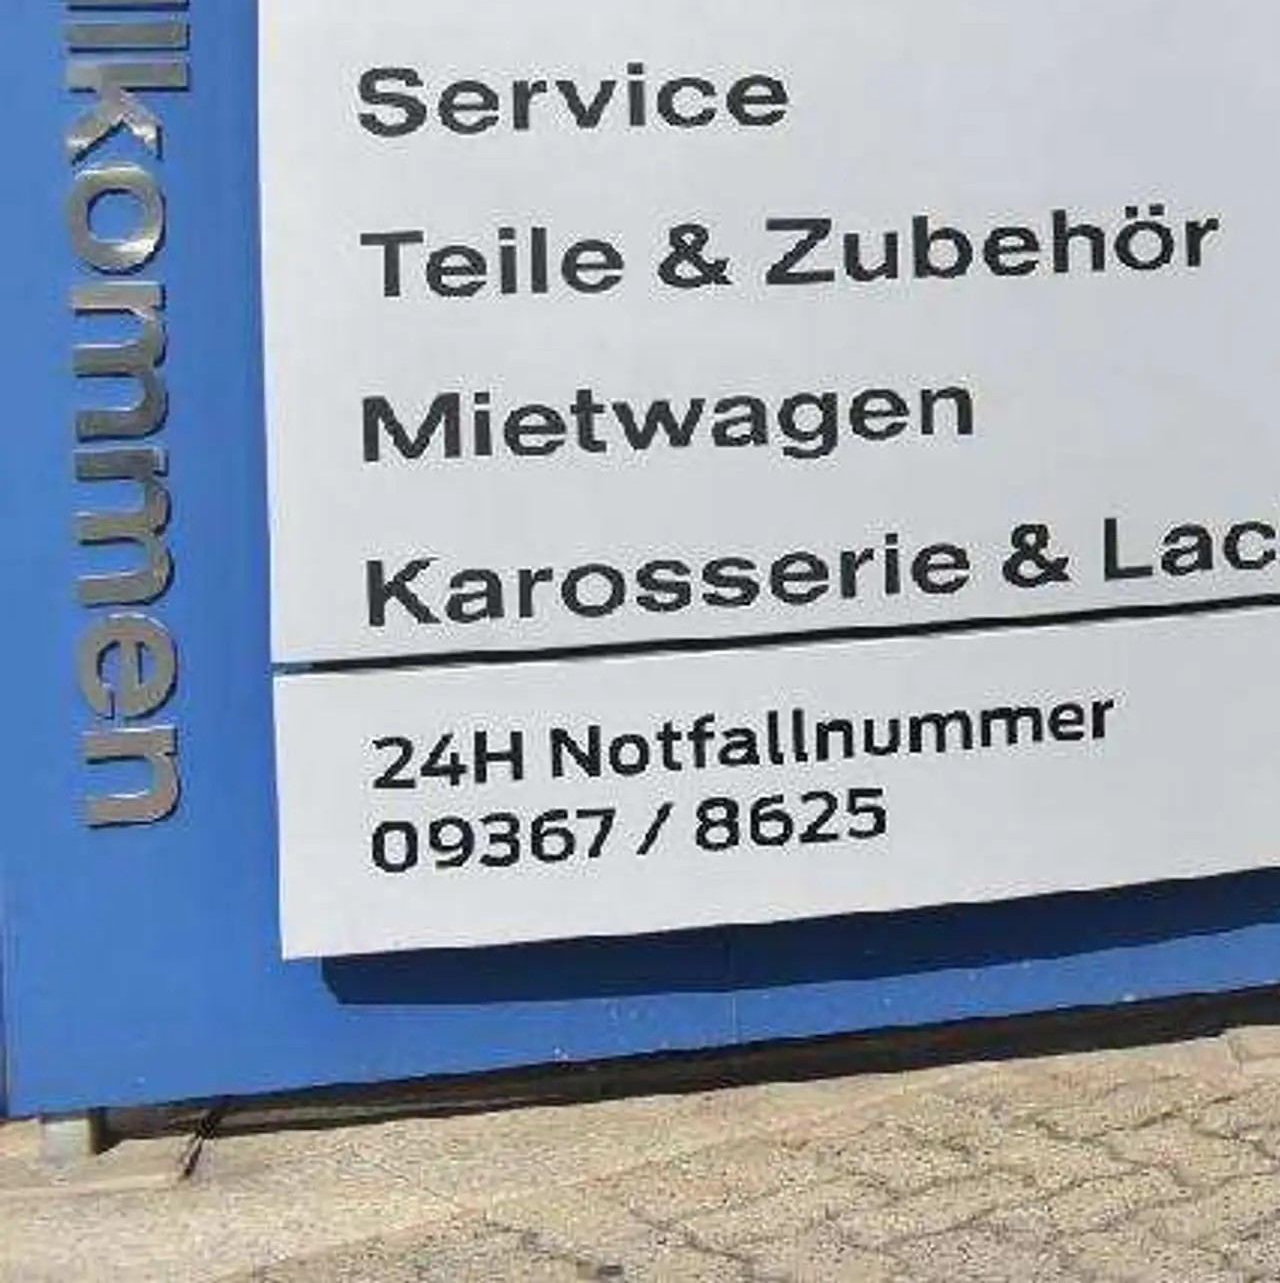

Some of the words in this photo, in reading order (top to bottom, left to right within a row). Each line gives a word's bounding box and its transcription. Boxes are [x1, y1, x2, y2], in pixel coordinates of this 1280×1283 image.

[357, 61, 790, 139] Service
[359, 225, 626, 299] Teile
[656, 222, 734, 291] &
[764, 202, 1221, 287] Zubehör
[361, 385, 974, 464] Mietwagen
[366, 532, 972, 629] Karosserie
[1000, 522, 1073, 590] &
[370, 729, 525, 791] 24H
[548, 697, 1116, 780] Notfallnummer
[370, 806, 618, 874] 09367
[635, 801, 675, 857] /
[694, 786, 888, 853] 8625
